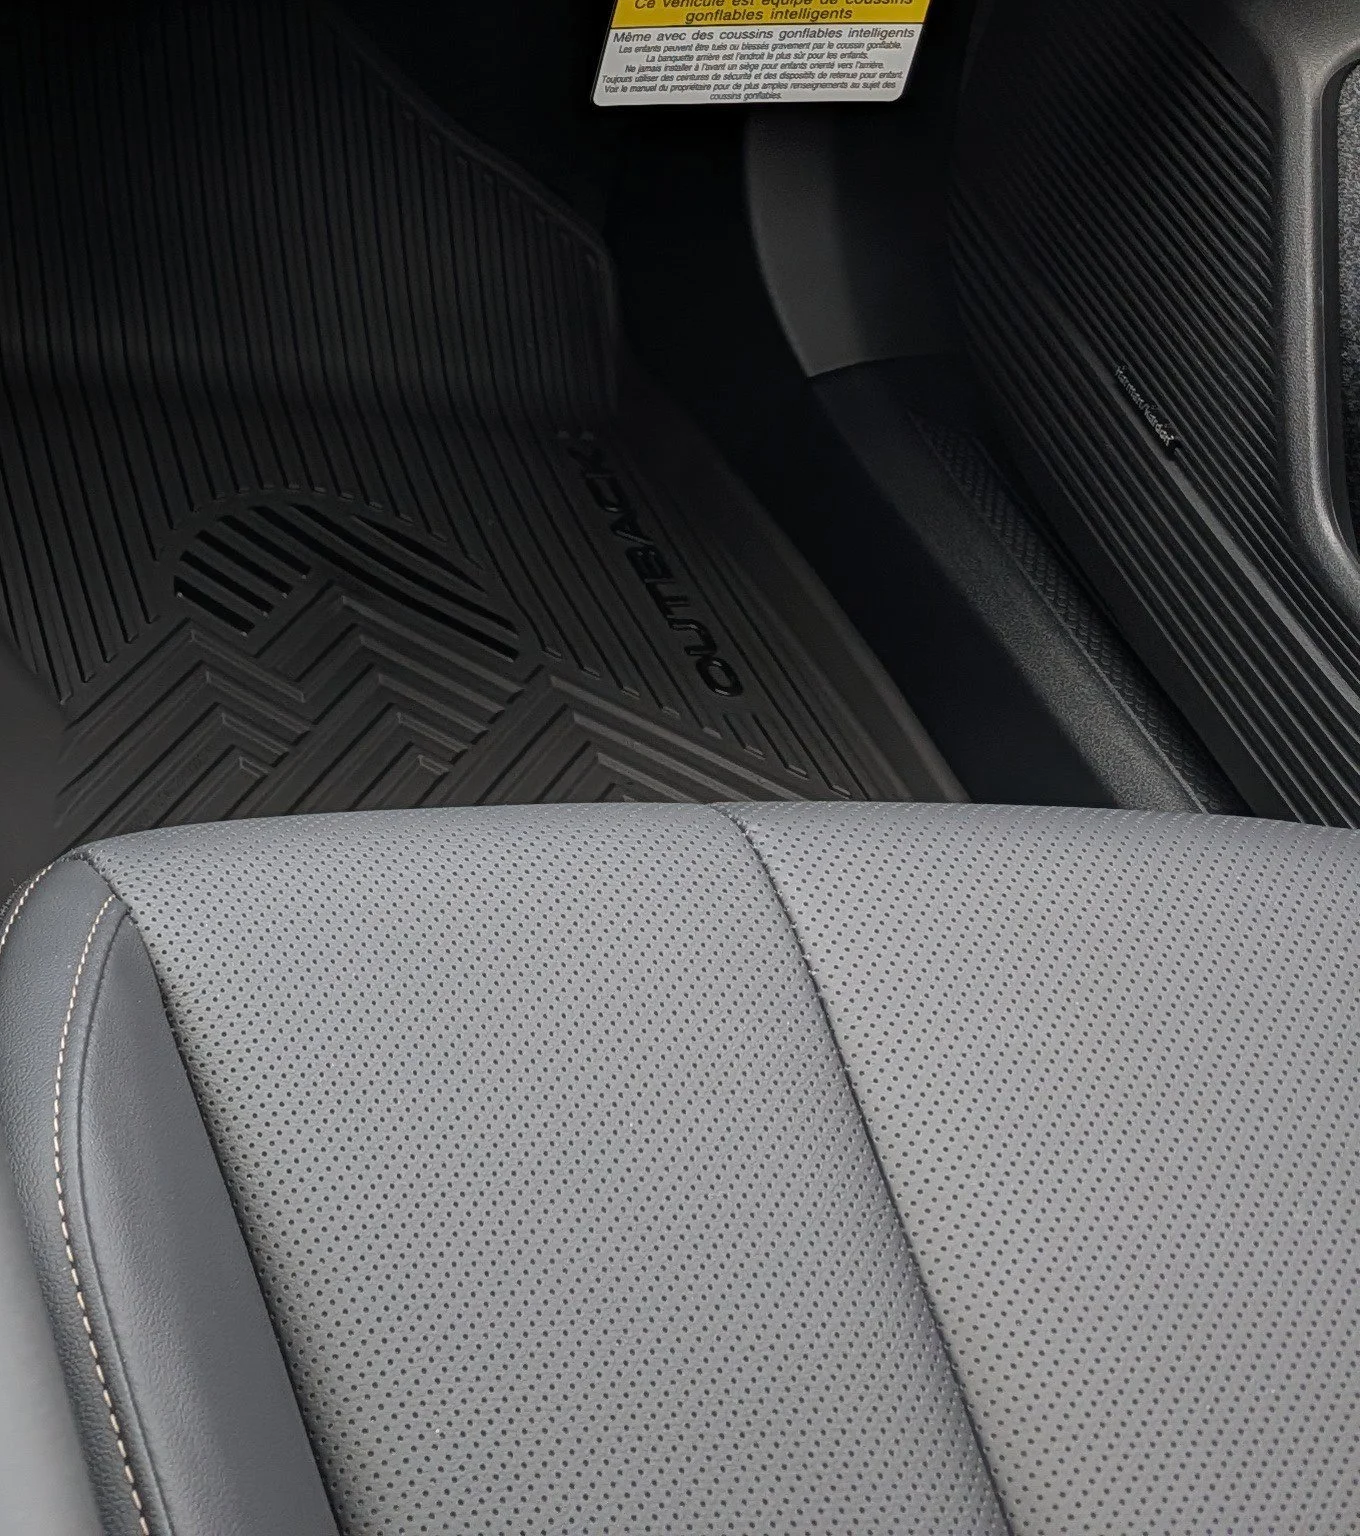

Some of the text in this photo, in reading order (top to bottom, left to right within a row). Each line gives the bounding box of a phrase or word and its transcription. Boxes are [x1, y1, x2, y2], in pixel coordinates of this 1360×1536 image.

[685, 8, 853, 24] gonflables intelligents
[613, 27, 915, 42] Même avec des coussins gonflables intelligents
